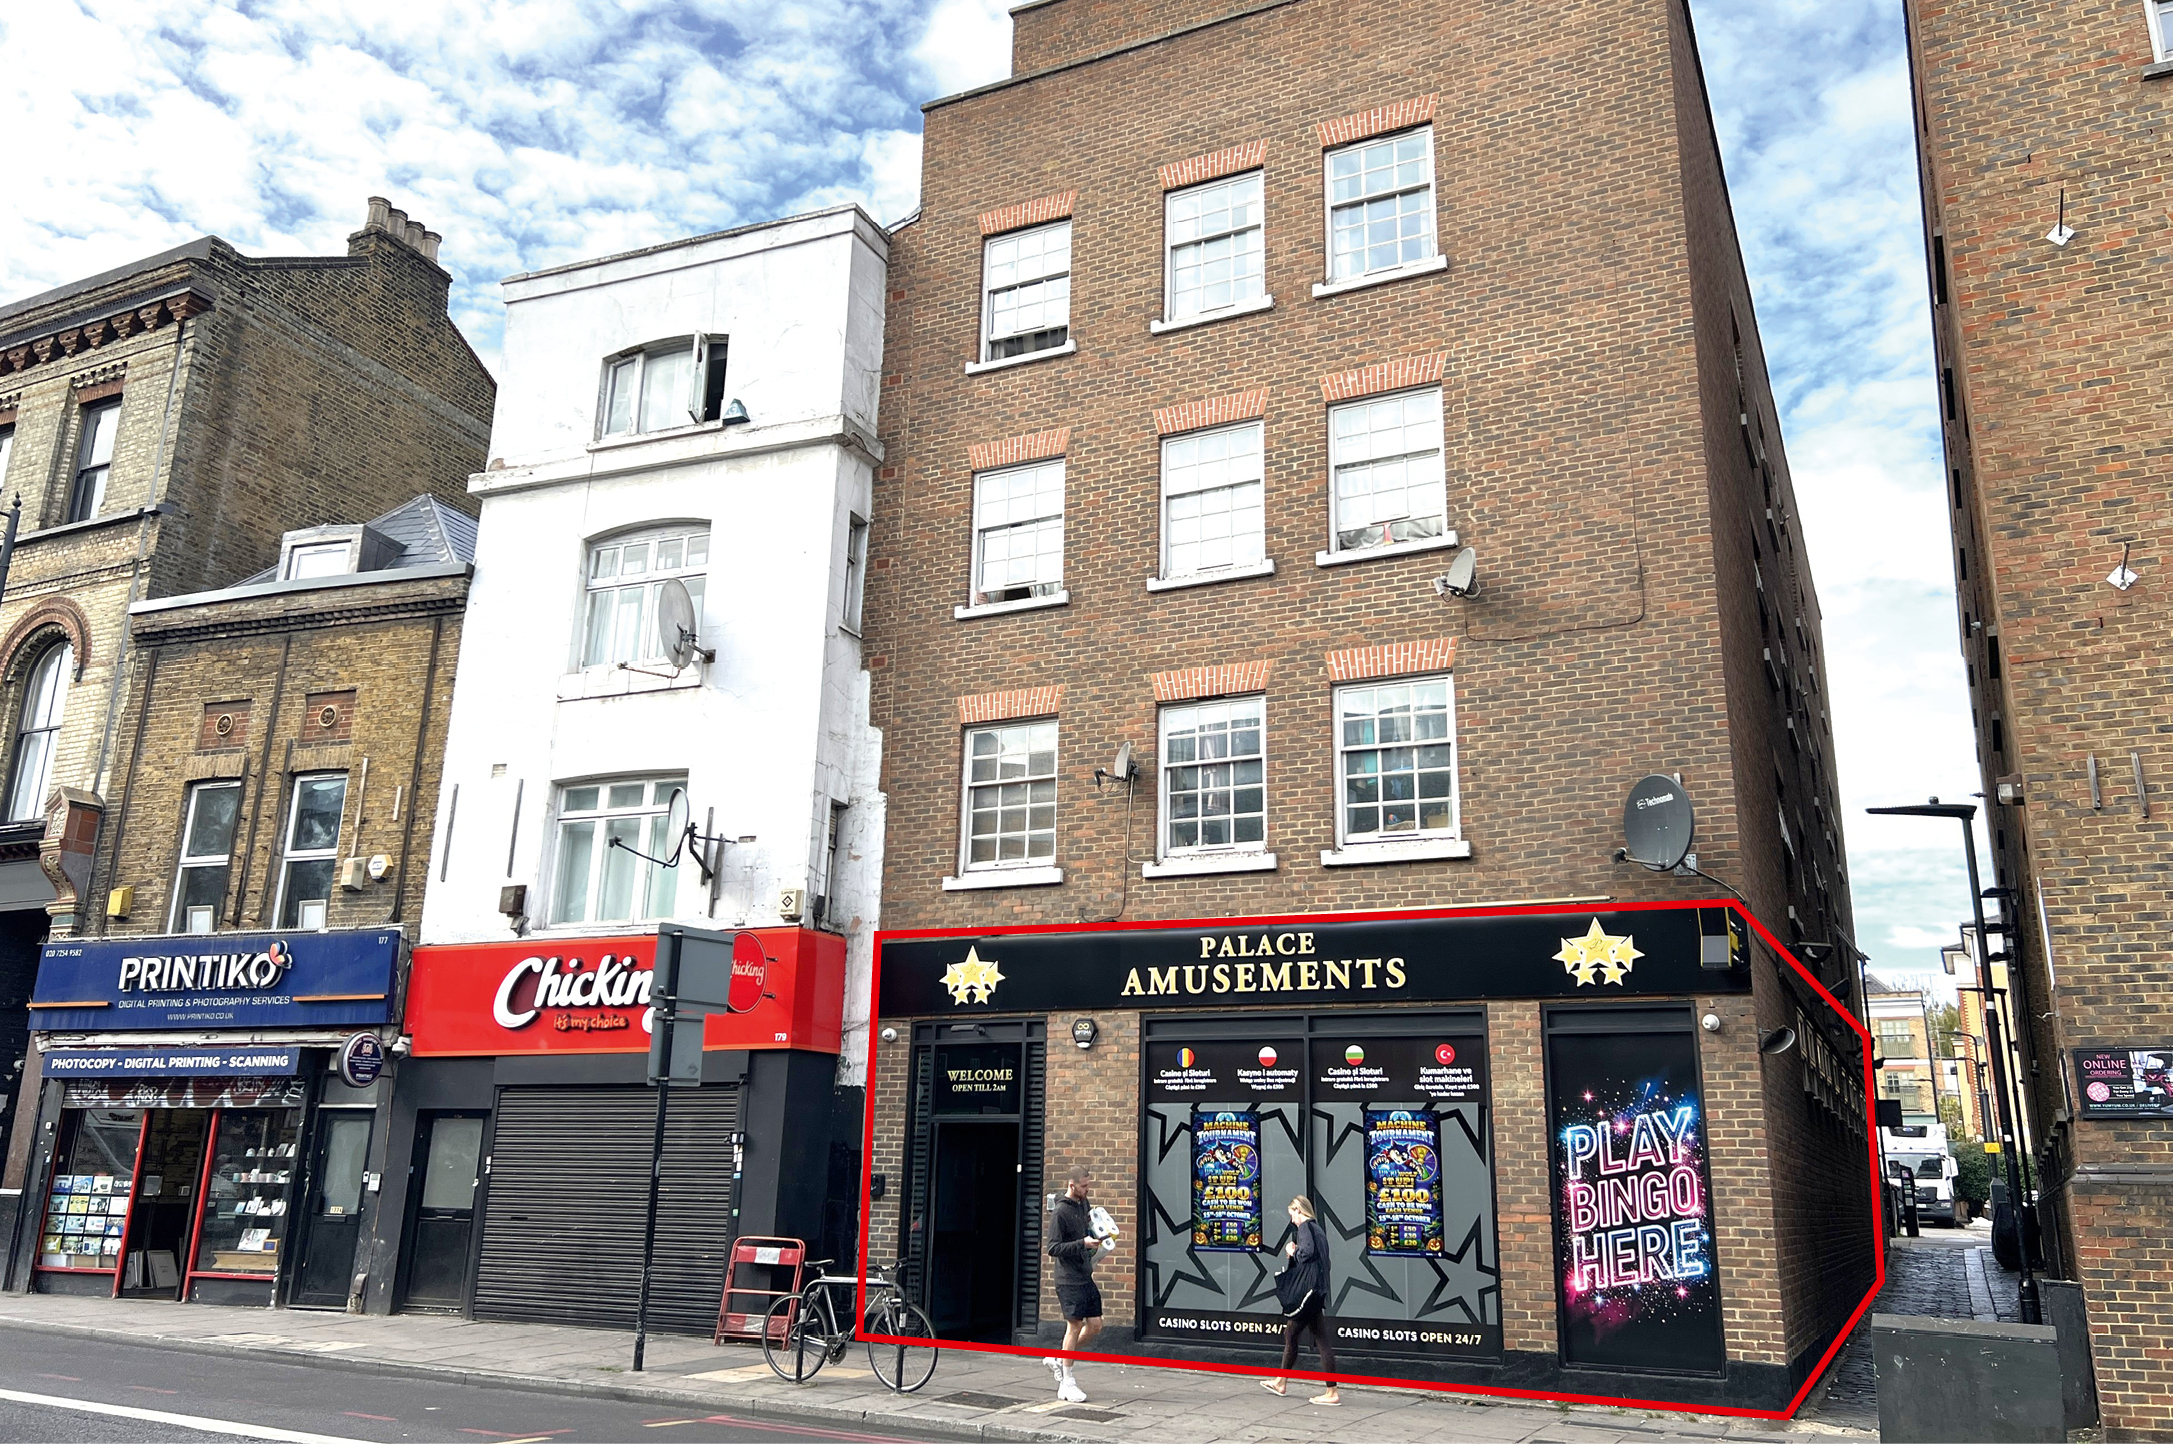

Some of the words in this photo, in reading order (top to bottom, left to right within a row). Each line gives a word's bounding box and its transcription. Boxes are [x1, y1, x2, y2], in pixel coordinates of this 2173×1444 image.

[1645, 792, 1674, 806] Technomate
[1200, 932, 1316, 958] PALACE
[118, 952, 280, 991] PRINTIKO
[1120, 958, 1406, 996] AMUSEMENTS
[192, 996, 250, 1006] PHOTOGRAPHY
[252, 996, 290, 1005] SERVICES
[571, 1018, 588, 1031] my
[590, 1015, 626, 1028] choice
[774, 1032, 787, 1041] 179
[51, 1058, 116, 1069] PHOTOCOPY
[124, 1057, 166, 1068] DIGITAL
[168, 1056, 220, 1068] PRINTING
[229, 1056, 288, 1067] SCANNING
[2083, 1060, 2126, 1069] ONLINE
[947, 1069, 1013, 1081] WELCOME
[1237, 1069, 1261, 1077] Kasyno
[1266, 1069, 1298, 1077] automaty
[1359, 1067, 1382, 1075] Sloturi
[1204, 1121, 1249, 1130] MACHINE
[1377, 1121, 1426, 1130] MACHINE
[1197, 1130, 1256, 1145] TOURNAMENT
[1369, 1129, 1434, 1145] TOURNAMENT
[1566, 1106, 1692, 1180] PLAY
[1204, 1186, 1250, 1200] £100
[1380, 1188, 1429, 1202] £100
[1569, 1166, 1698, 1232] BINGO
[1573, 1218, 1704, 1291] HERE
[1159, 1317, 1198, 1329] CASINO
[1200, 1320, 1231, 1331] SLOTS
[1234, 1321, 1262, 1333] OPEN
[1338, 1327, 1379, 1339] CASINO
[1383, 1330, 1417, 1341] SLOTS
[1420, 1332, 1452, 1344] OPEN
[1455, 1333, 1481, 1345] 24/7
